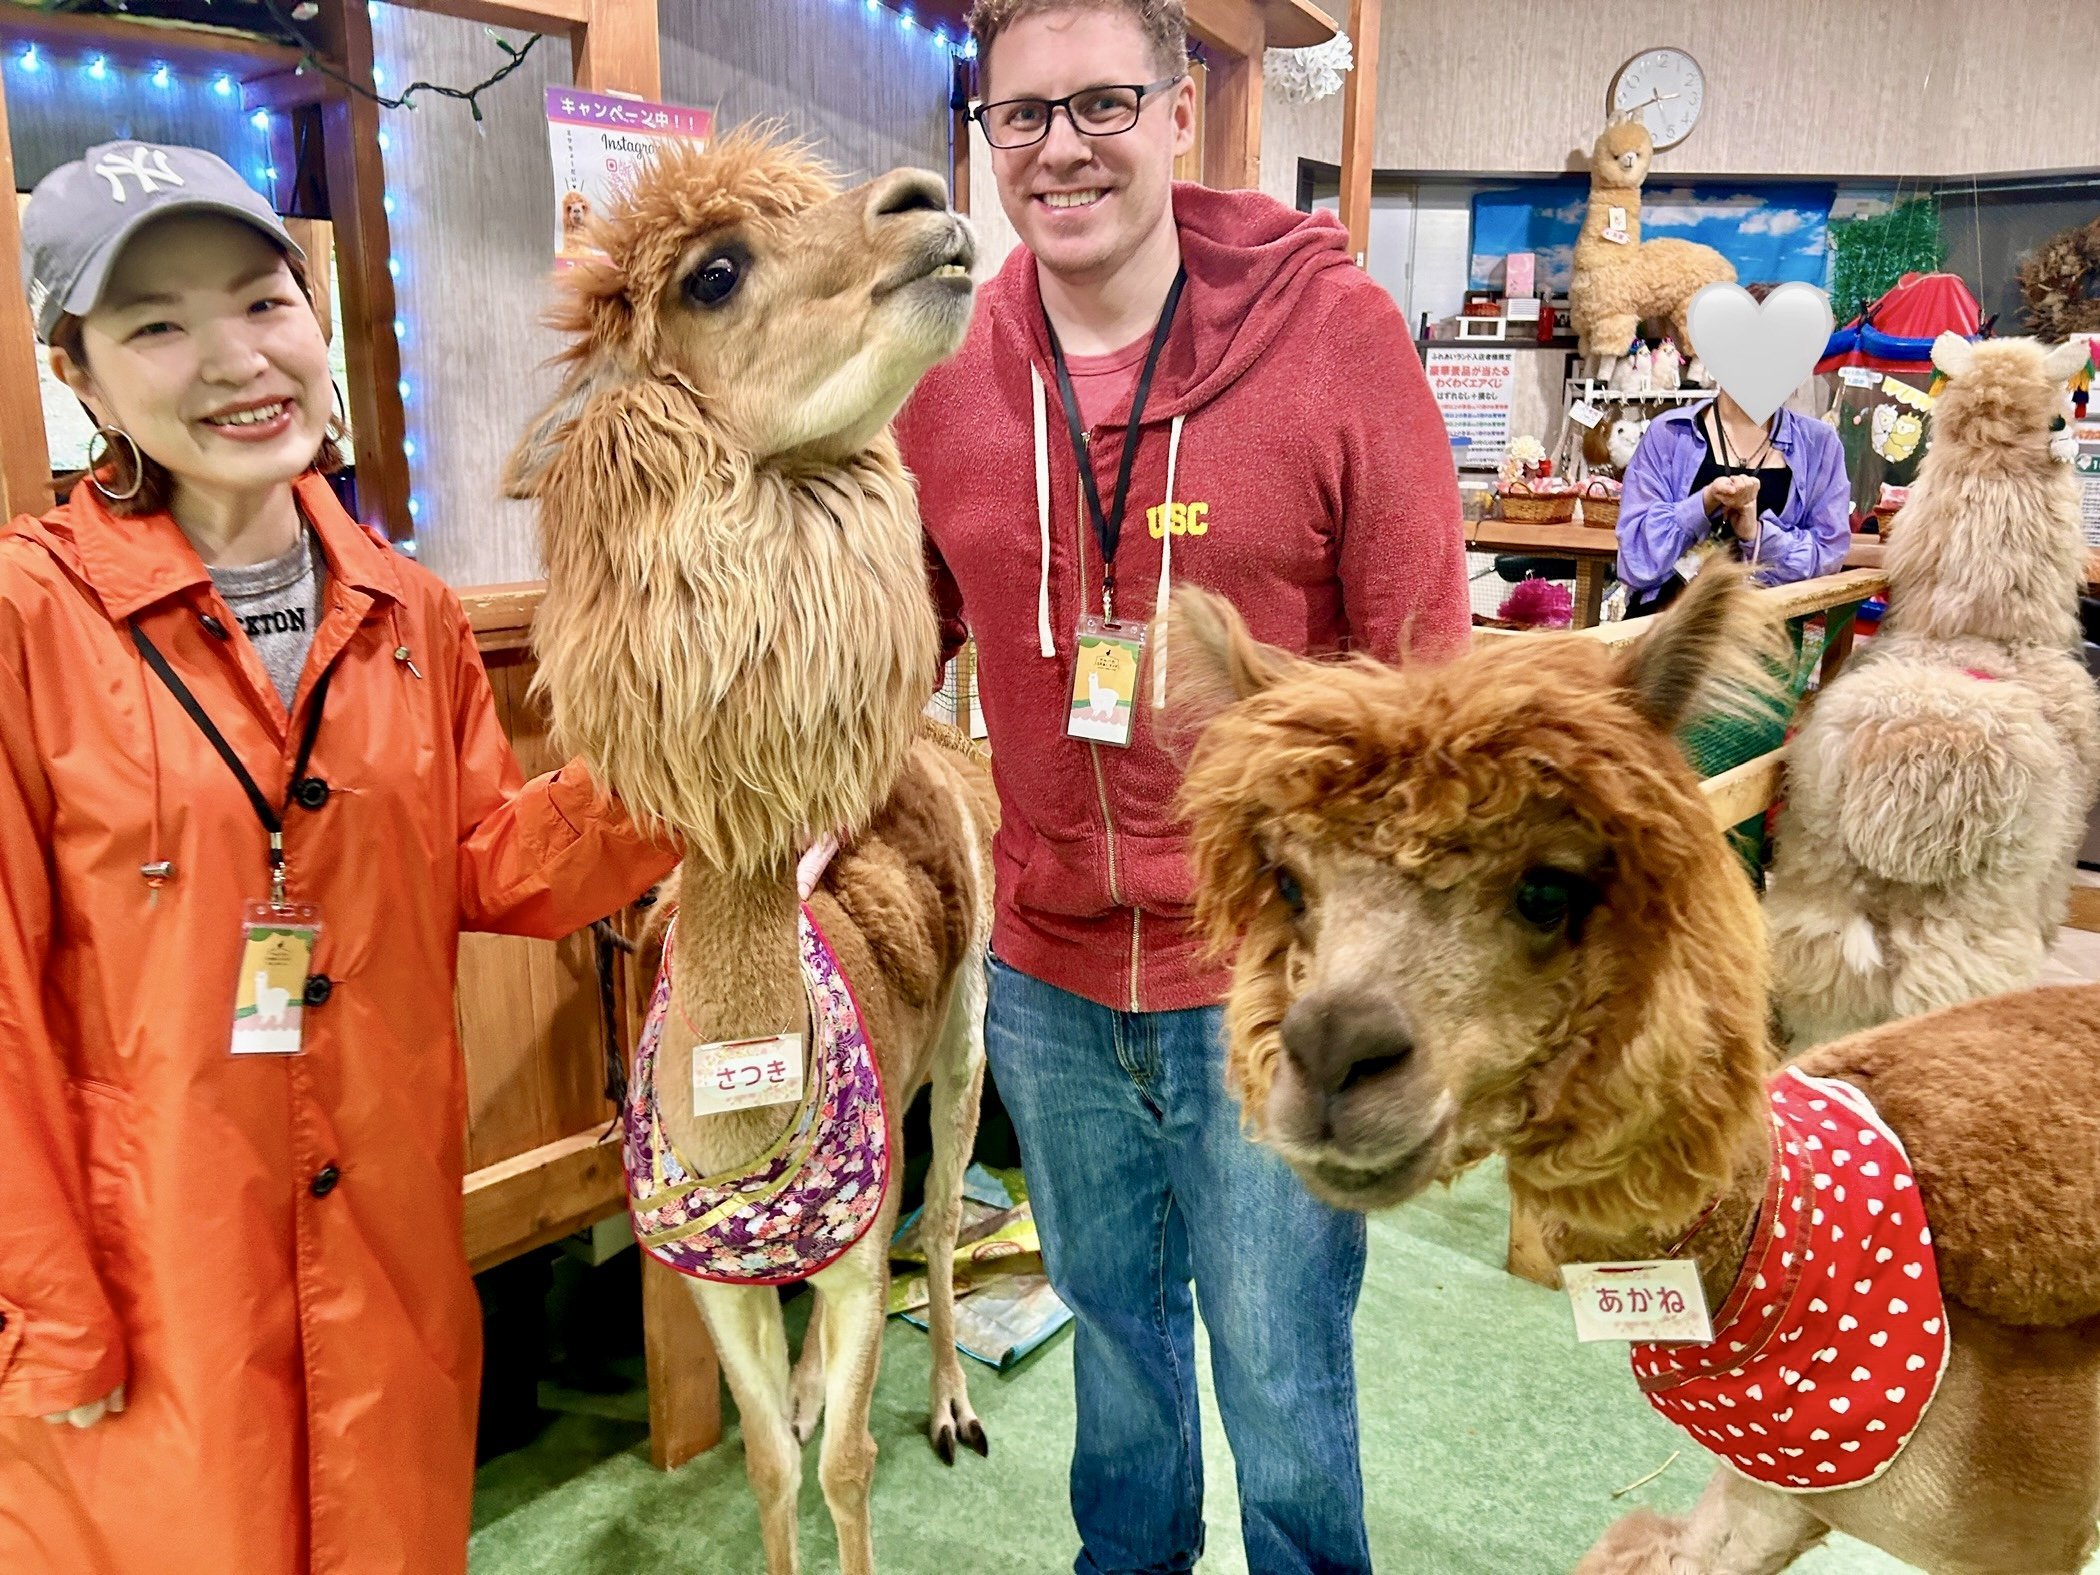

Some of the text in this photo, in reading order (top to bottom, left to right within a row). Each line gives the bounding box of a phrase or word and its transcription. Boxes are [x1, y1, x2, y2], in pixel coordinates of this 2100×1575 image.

[95, 146, 184, 202] NY
[1436, 378, 1503, 389] わくわくエアくじ
[1145, 502, 1209, 539] USC
[716, 1060, 786, 1090] さつき
[1596, 1286, 1686, 1313] あかね
